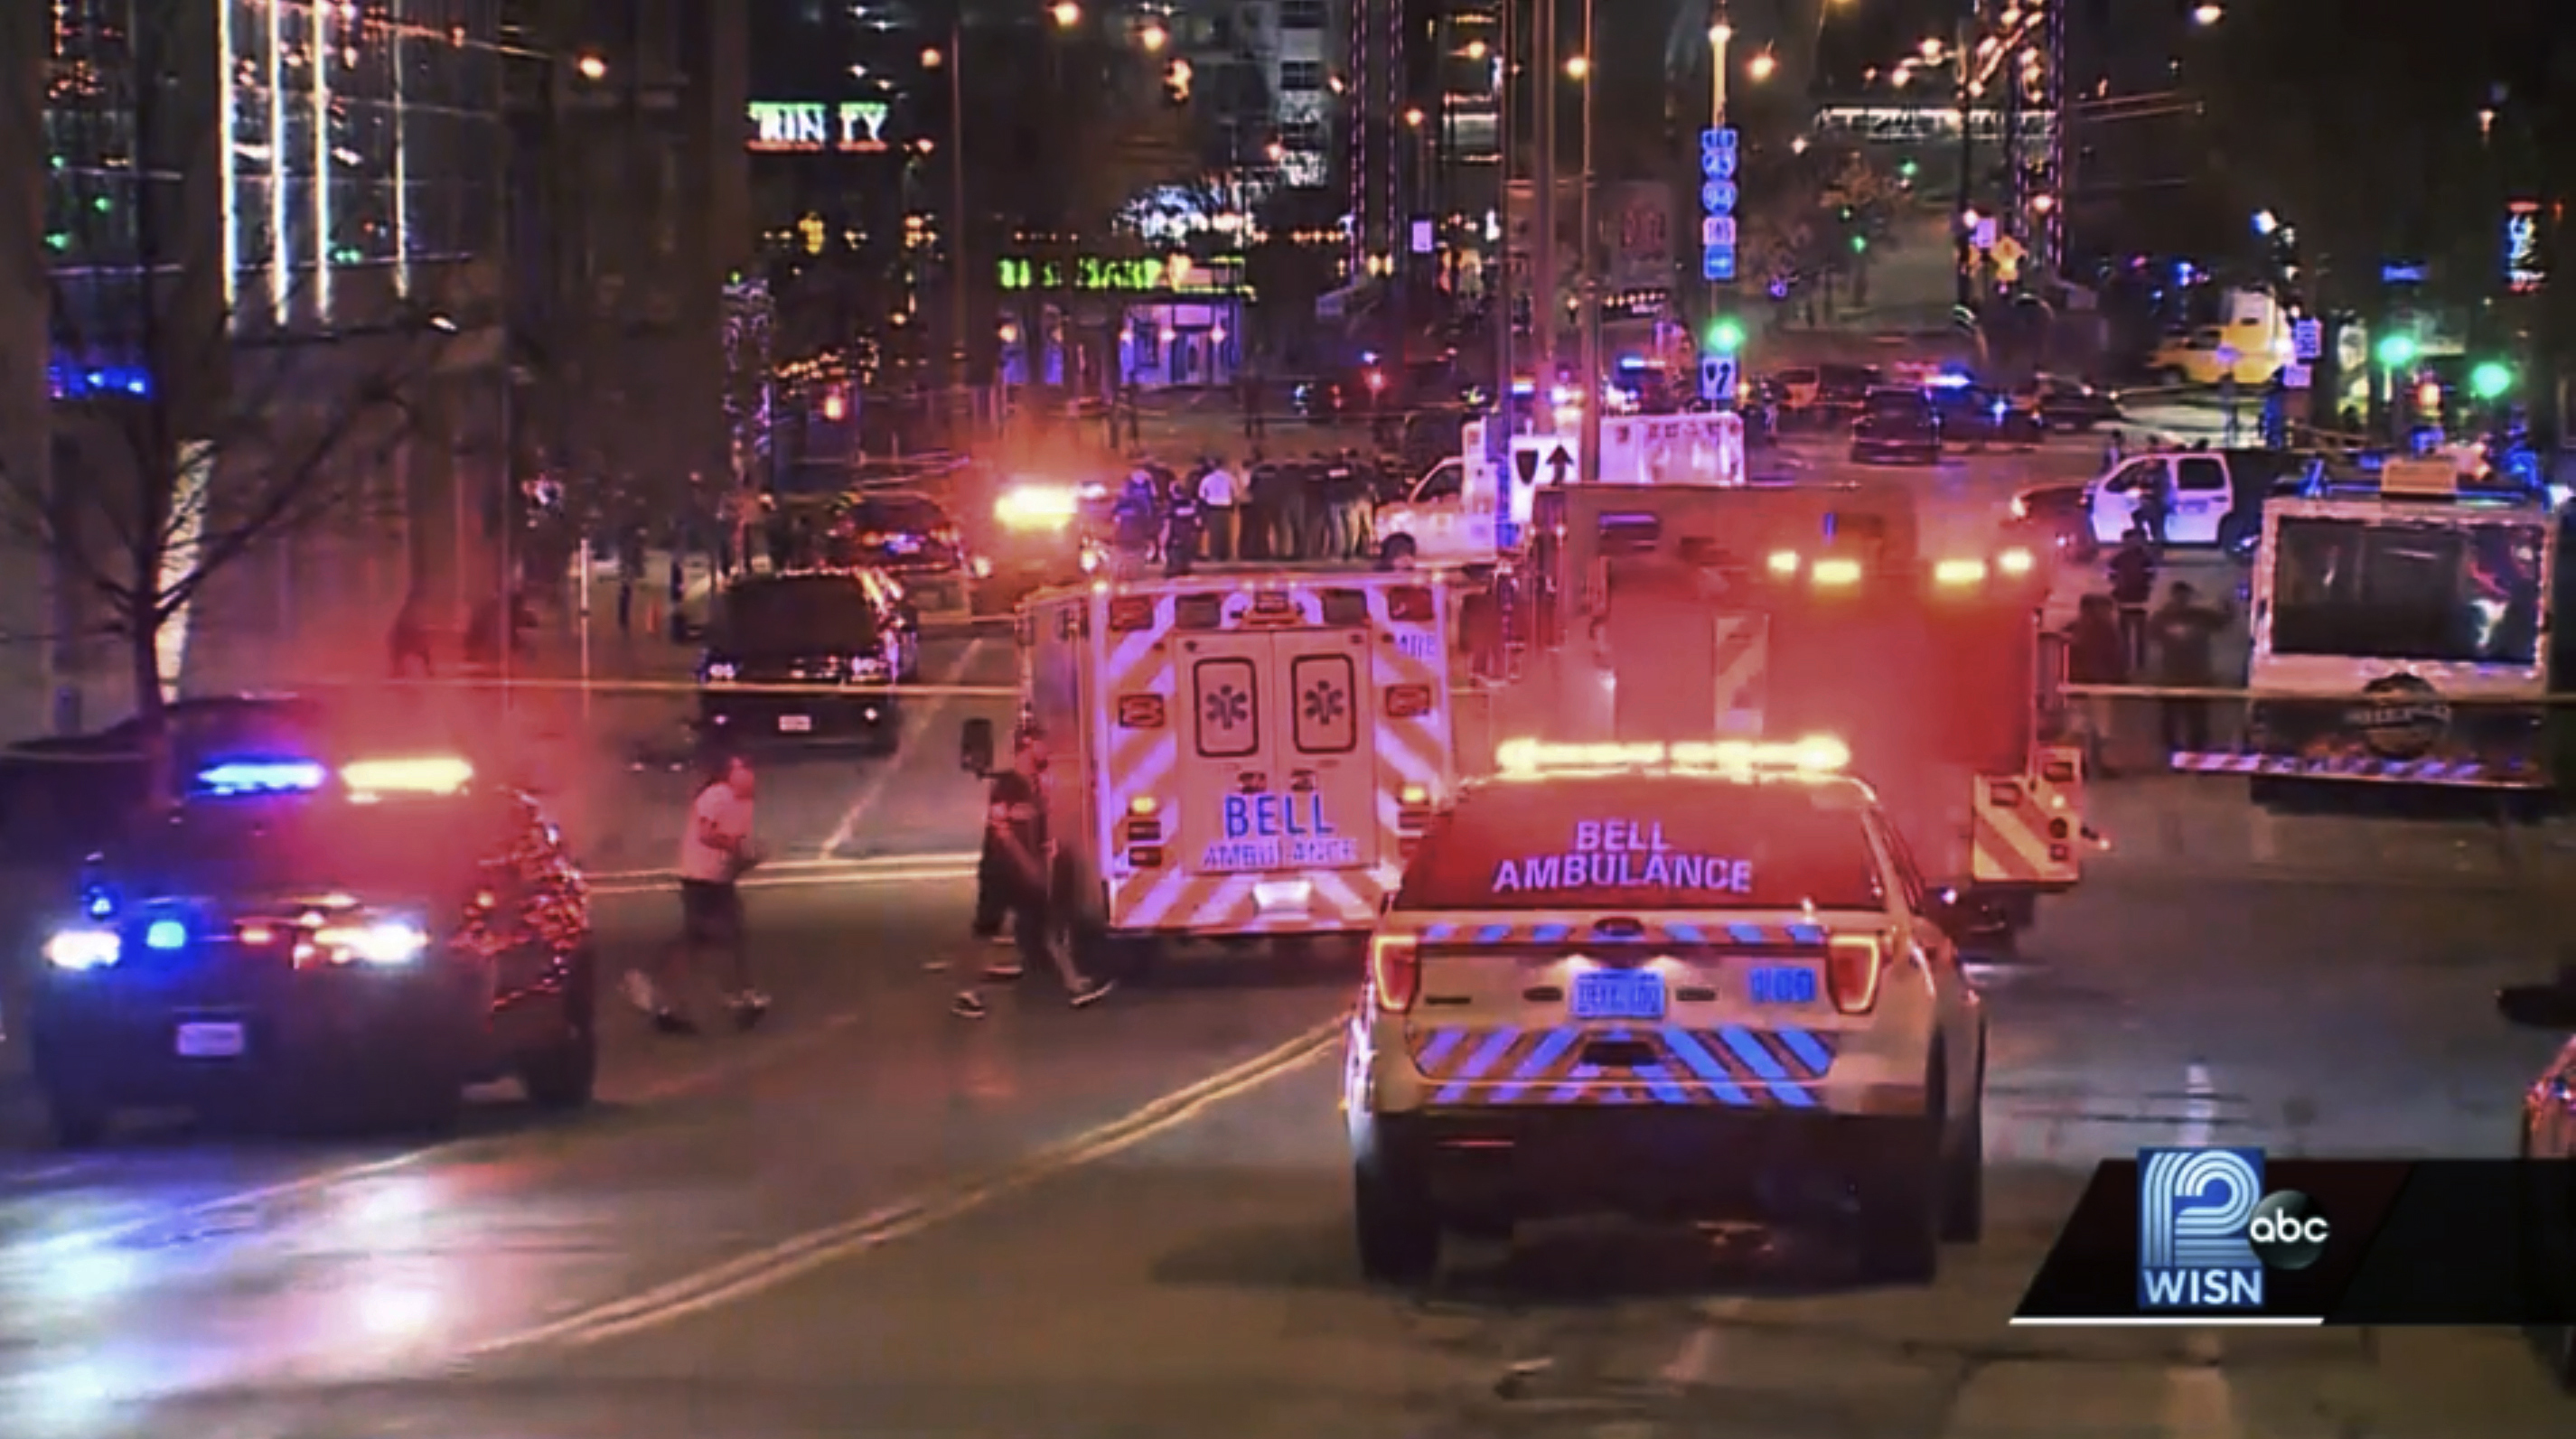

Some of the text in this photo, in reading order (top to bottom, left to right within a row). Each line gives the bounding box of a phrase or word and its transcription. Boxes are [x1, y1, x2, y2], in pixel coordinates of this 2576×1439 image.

[1225, 795, 1335, 838] BELL
[1576, 819, 1670, 851] BELL
[1492, 853, 1753, 893] AMBULANCE
